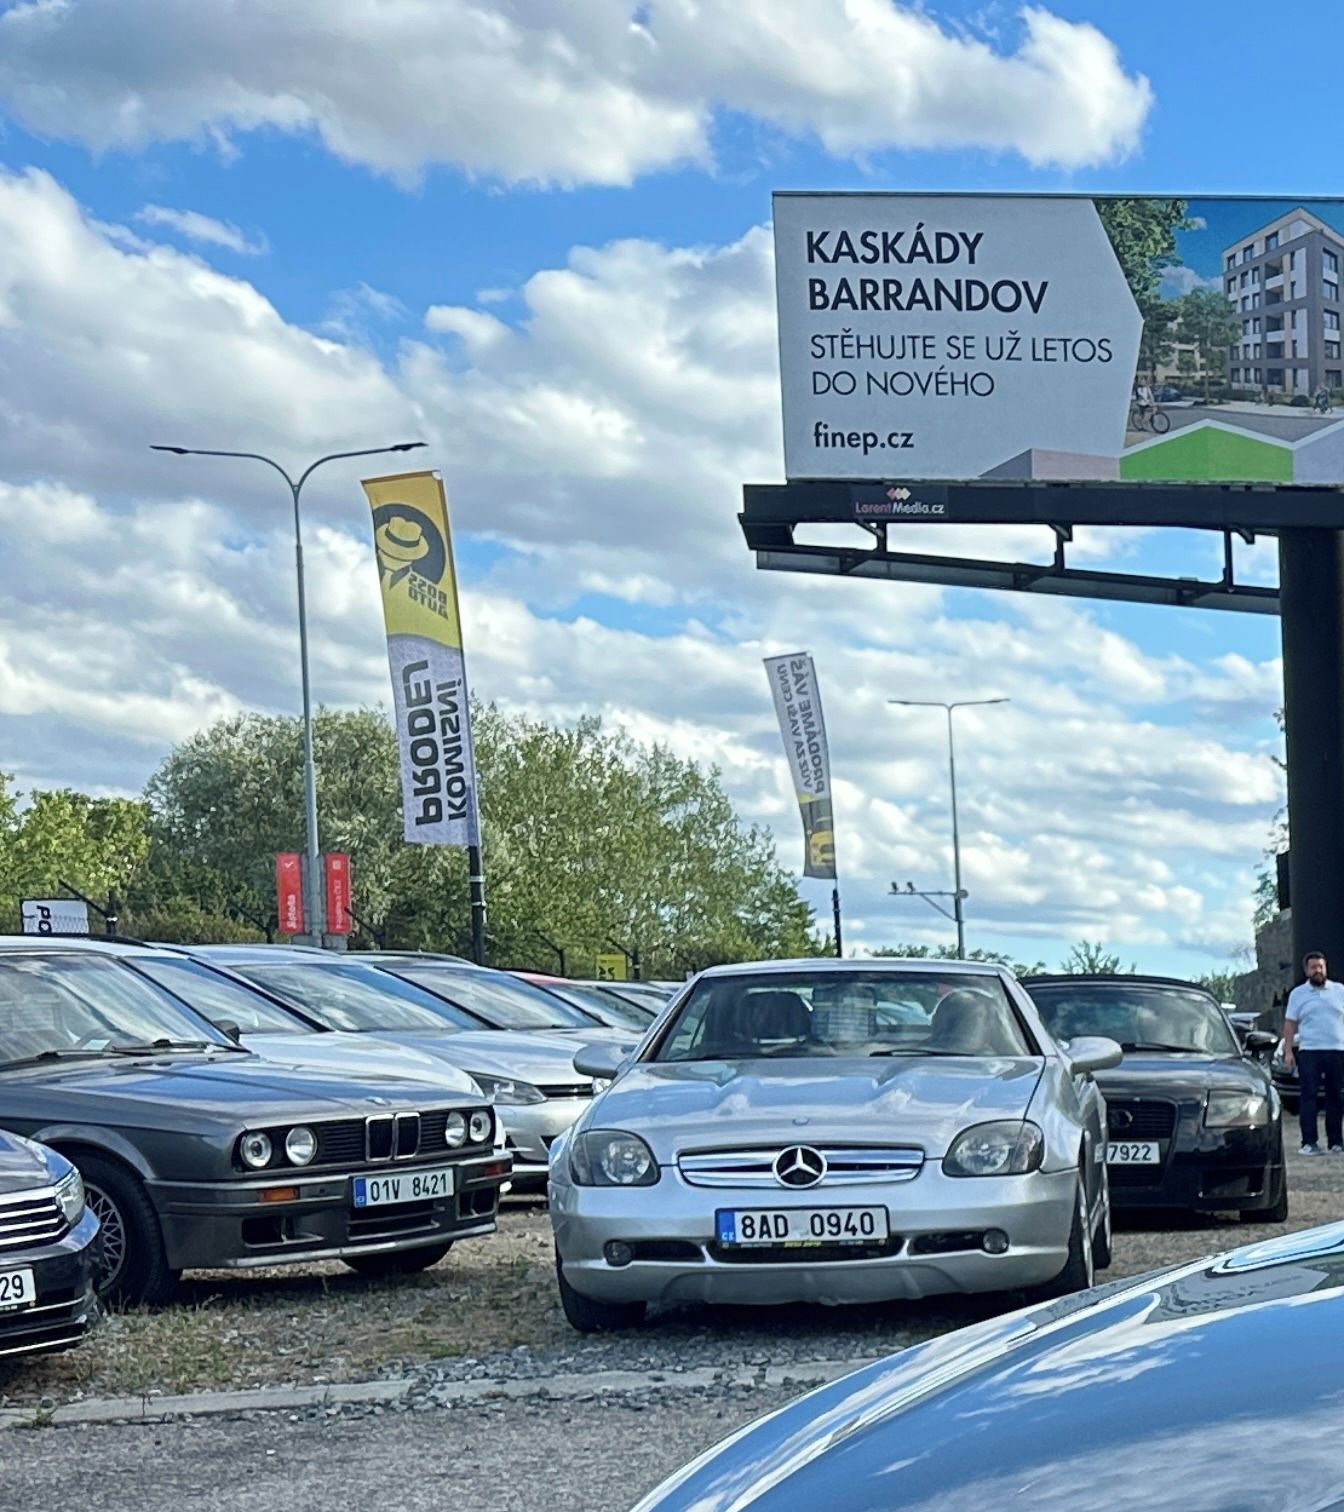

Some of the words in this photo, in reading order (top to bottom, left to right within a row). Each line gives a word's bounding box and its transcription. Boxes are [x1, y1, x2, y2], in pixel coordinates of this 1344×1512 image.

[806, 222, 984, 264] KASKÁDY
[808, 278, 1049, 314] BARRANDOV
[810, 328, 937, 360] STĚHUJTE
[946, 335, 976, 360] SE
[985, 330, 1023, 361] UŽ
[1031, 338, 1113, 363] LETOS
[812, 371, 857, 396] DO
[867, 365, 995, 397] NOVÉHO
[813, 421, 915, 455] finep.cz
[1108, 1144, 1152, 1161] 7922
[370, 1179, 400, 1202] 01V
[412, 1173, 447, 1197] 8421
[741, 1214, 789, 1239] 8AD
[810, 1212, 875, 1237] 0940
